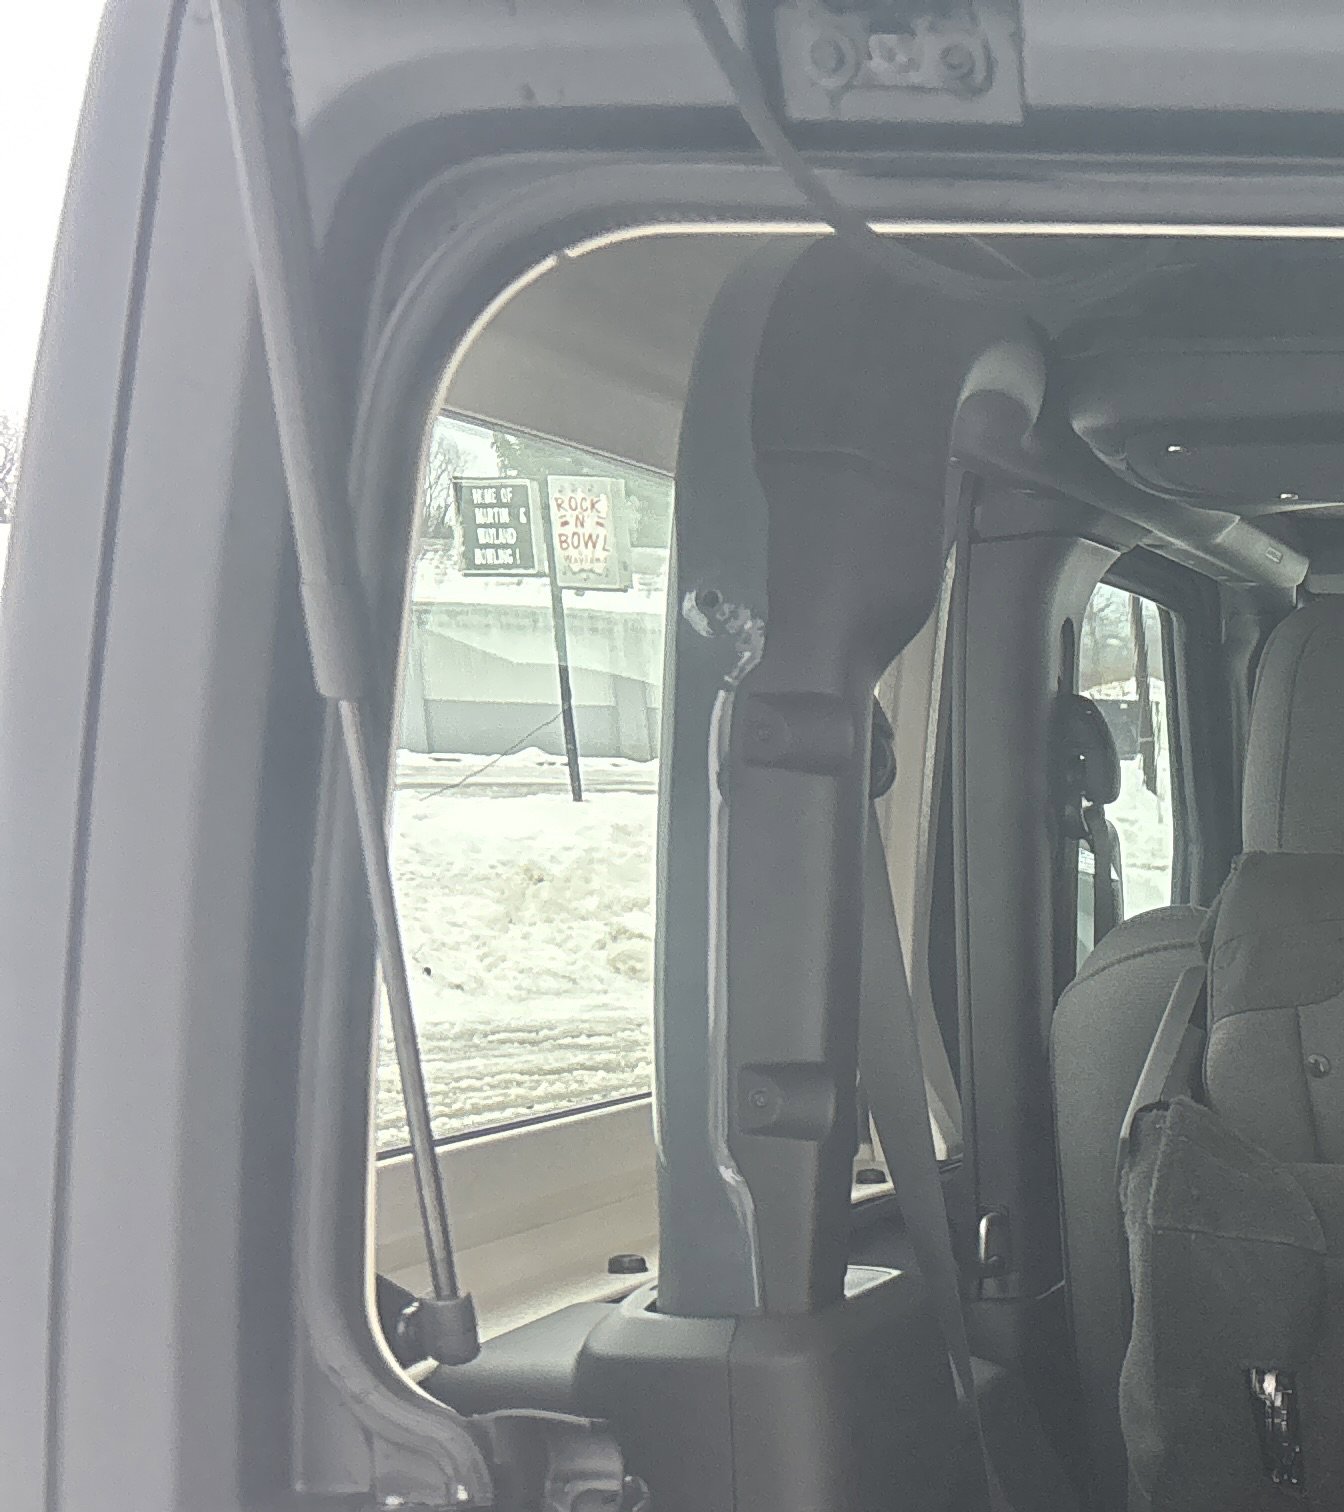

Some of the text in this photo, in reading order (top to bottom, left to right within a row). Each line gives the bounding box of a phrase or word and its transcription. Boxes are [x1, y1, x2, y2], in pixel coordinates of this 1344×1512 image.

[554, 496, 601, 513] ROCK
[476, 528, 518, 544] WAYLAND
[558, 531, 611, 552] BOWL
